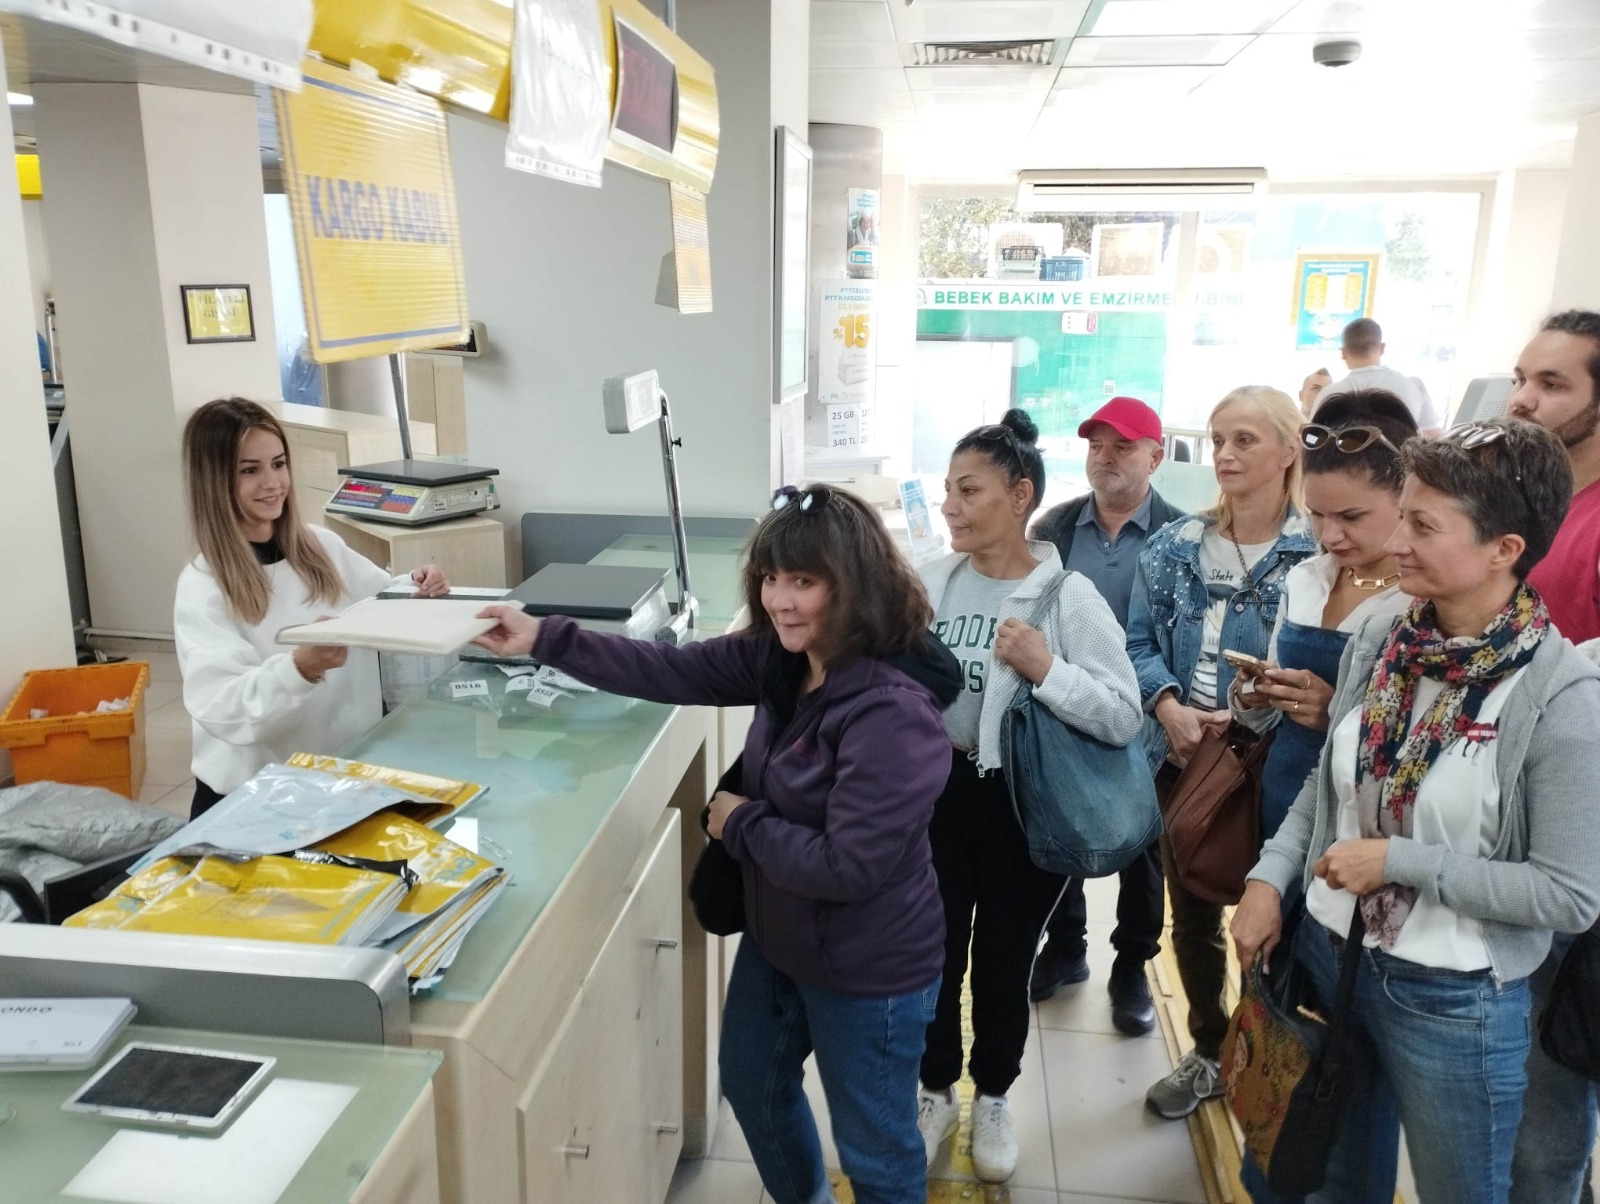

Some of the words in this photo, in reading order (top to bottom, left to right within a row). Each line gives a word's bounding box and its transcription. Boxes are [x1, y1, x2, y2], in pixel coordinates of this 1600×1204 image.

[306, 174, 383, 242] KARGO
[935, 291, 993, 304] BEBEK
[999, 291, 1054, 305] BAKIM
[1061, 291, 1083, 305] VE
[1090, 289, 1171, 305] EMZİRME
[832, 412, 842, 420] 25
[844, 410, 855, 419] GB
[833, 439, 847, 447] 340
[848, 437, 857, 445] TL
[1209, 568, 1234, 581] State
